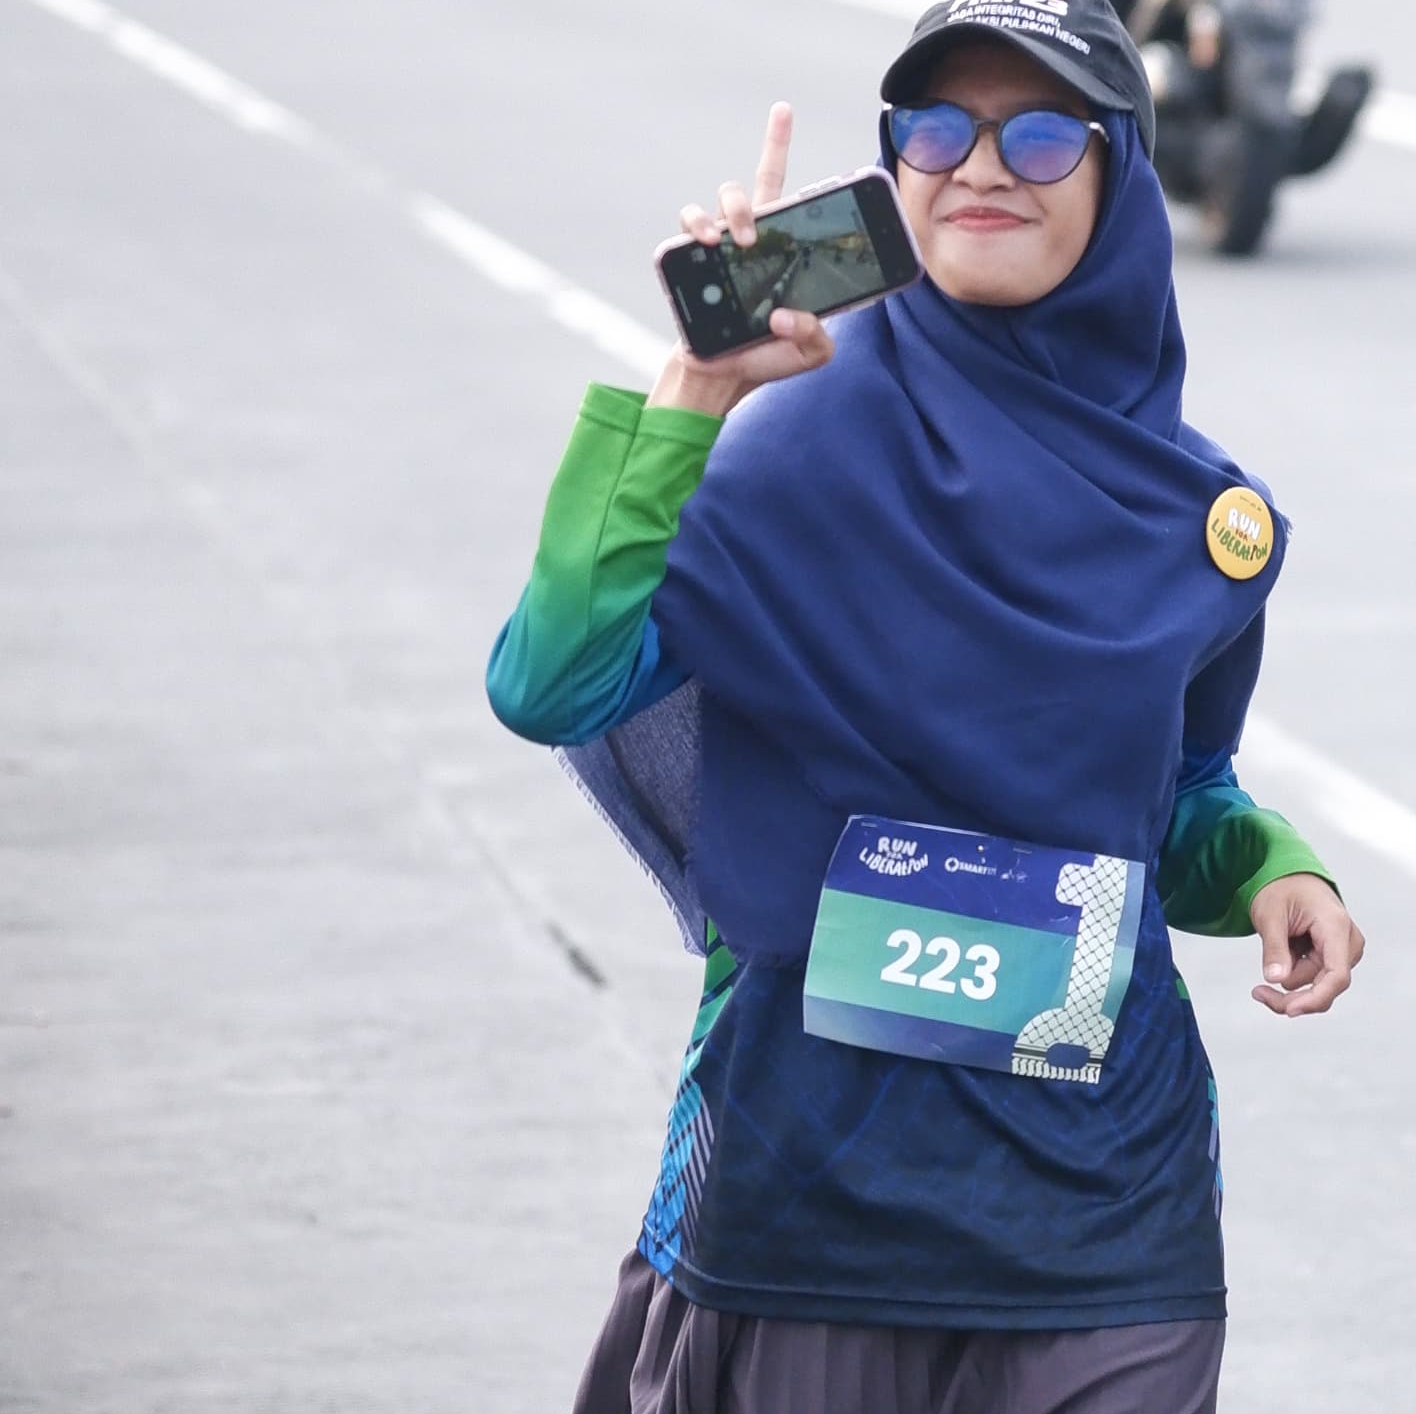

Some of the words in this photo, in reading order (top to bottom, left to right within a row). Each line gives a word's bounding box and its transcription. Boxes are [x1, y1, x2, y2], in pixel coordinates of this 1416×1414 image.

[947, 7, 974, 23] JAGA
[974, 4, 1035, 21] INTEGRITAS
[1001, 17, 1055, 36] PULIHKAN
[1055, 28, 1091, 55] NEGERI
[1228, 508, 1262, 540] RUN
[1235, 529, 1248, 541] FOR
[1211, 518, 1267, 560] LIBERATION
[878, 836, 918, 857] RUN
[886, 852, 903, 861] FOR
[859, 847, 928, 876] LIBERATION
[880, 928, 1000, 1001] 223
